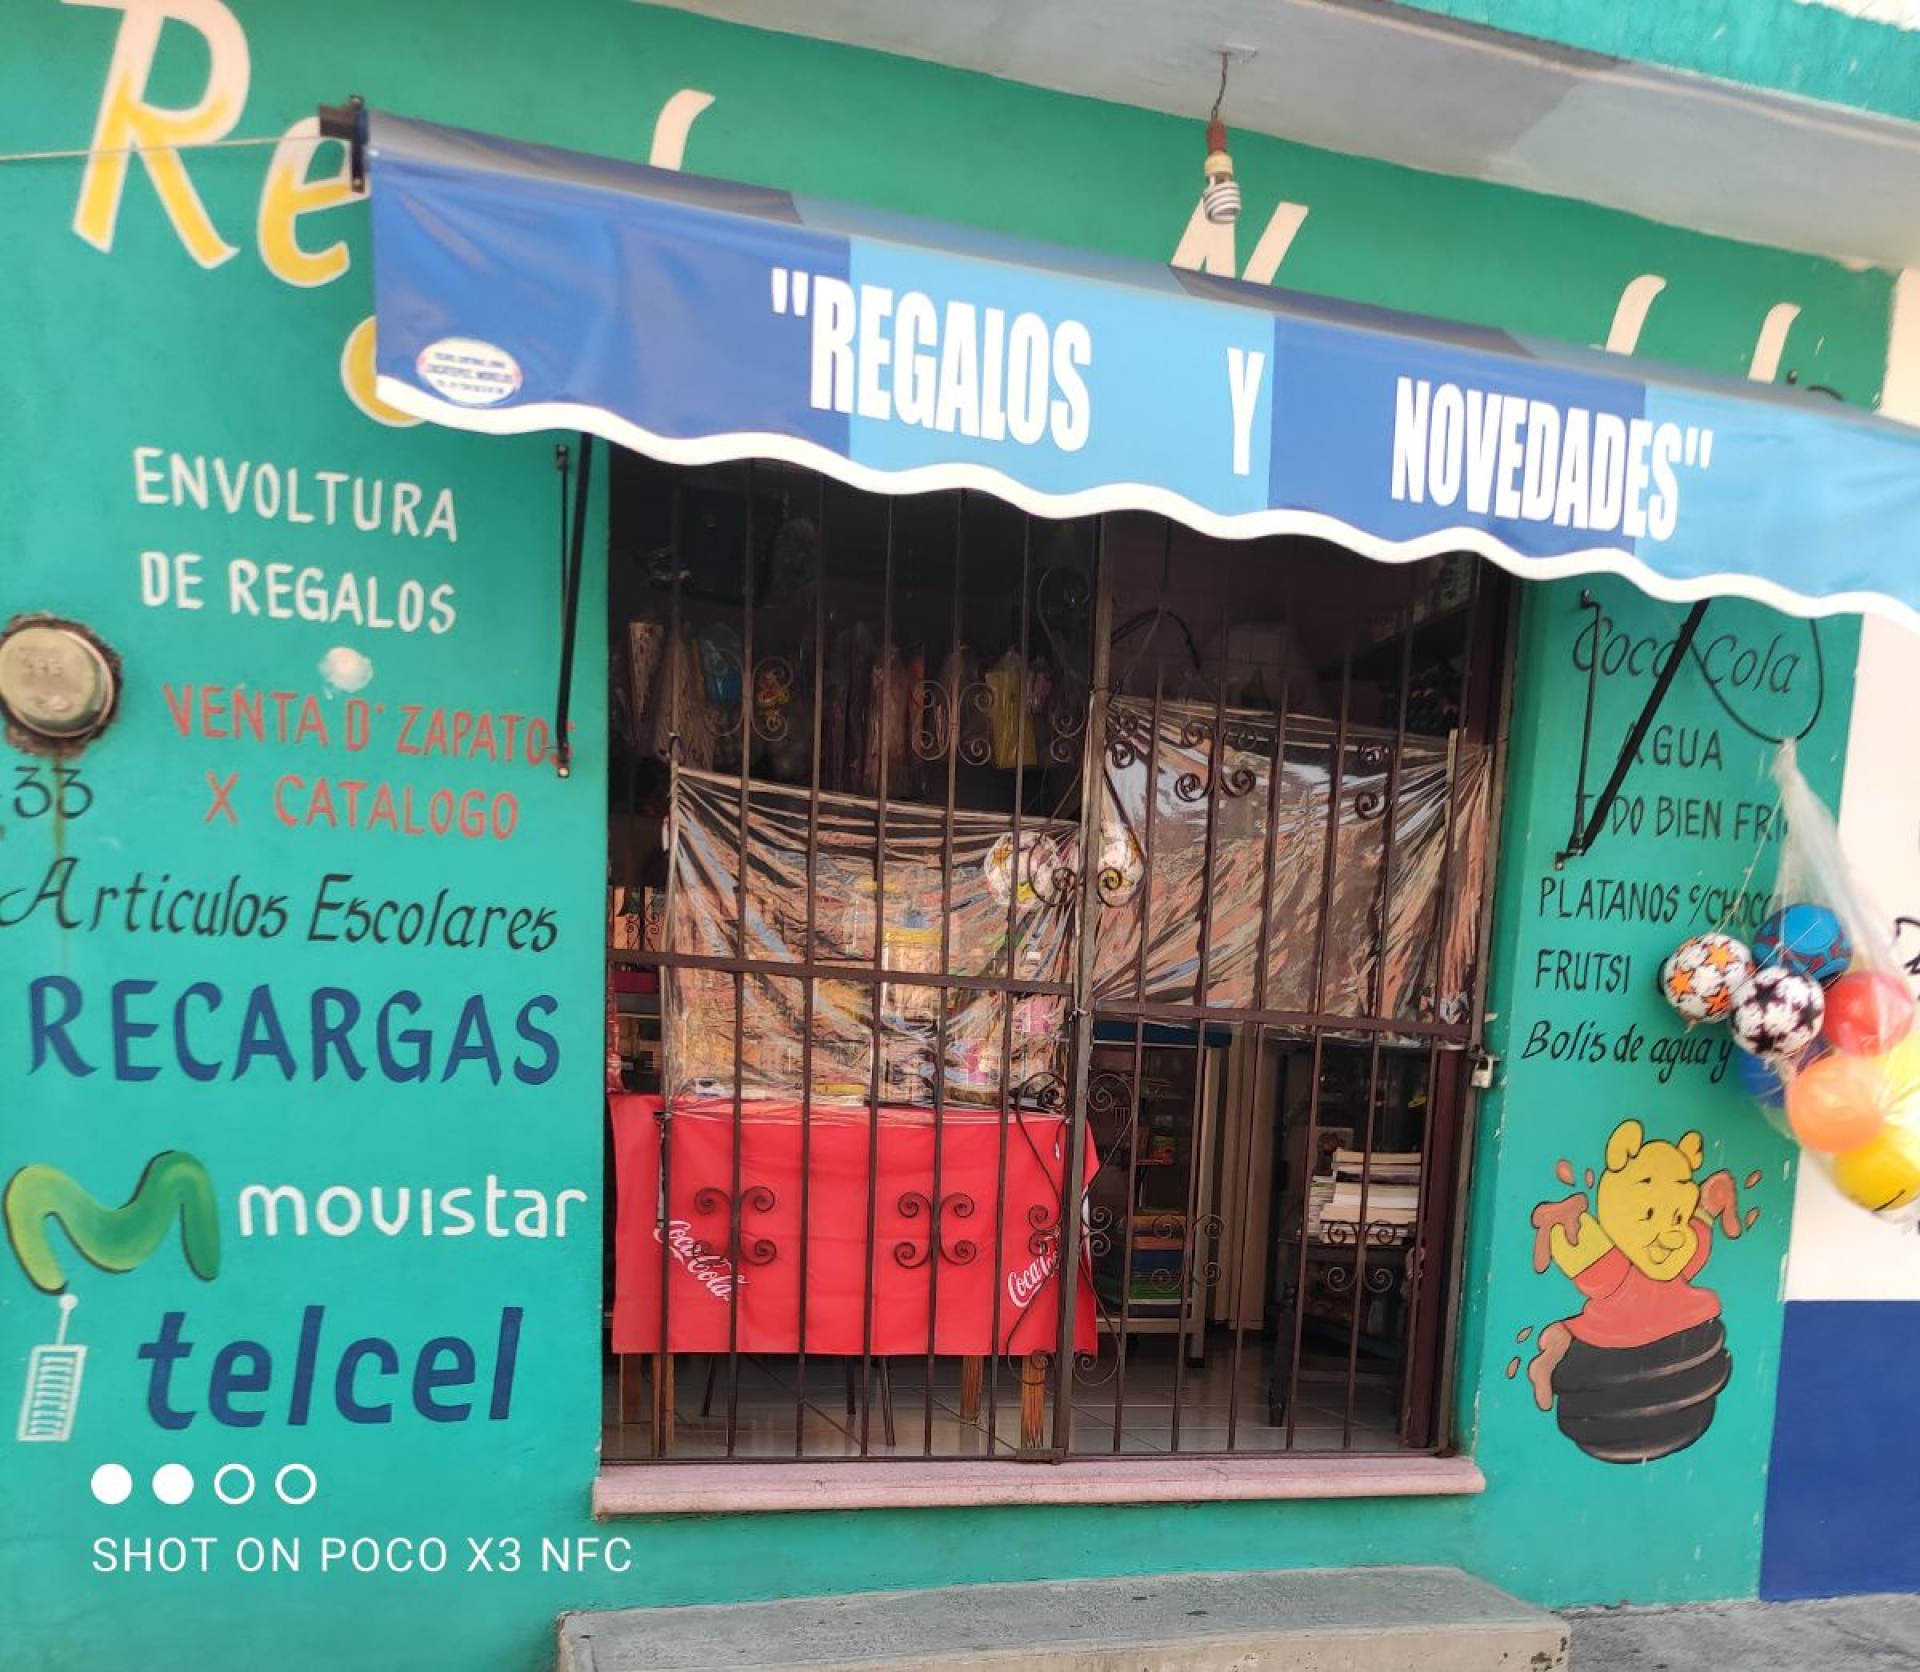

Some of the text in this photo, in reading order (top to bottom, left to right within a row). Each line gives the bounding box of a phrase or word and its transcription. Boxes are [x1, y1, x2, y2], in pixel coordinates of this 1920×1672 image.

[771, 268, 1714, 542] "REGALOS Y NOVEDADES"
[134, 447, 458, 543] ENVOLTURA
[140, 551, 456, 635] DE REGALOS
[1703, 633, 1799, 694] Cola
[163, 683, 328, 748] VENTA
[205, 772, 518, 840] X CATALOGO
[1656, 796, 1722, 838] BIEN
[0, 857, 558, 953] Articulos Escolares
[1539, 876, 1680, 924] PLATANOS
[1535, 949, 1630, 995] FRUTSI
[27, 975, 561, 1087] RECARGAS
[1521, 1021, 1737, 1084] Bolis de agua y
[239, 1174, 587, 1238] movistar
[137, 1305, 524, 1430] telcel
